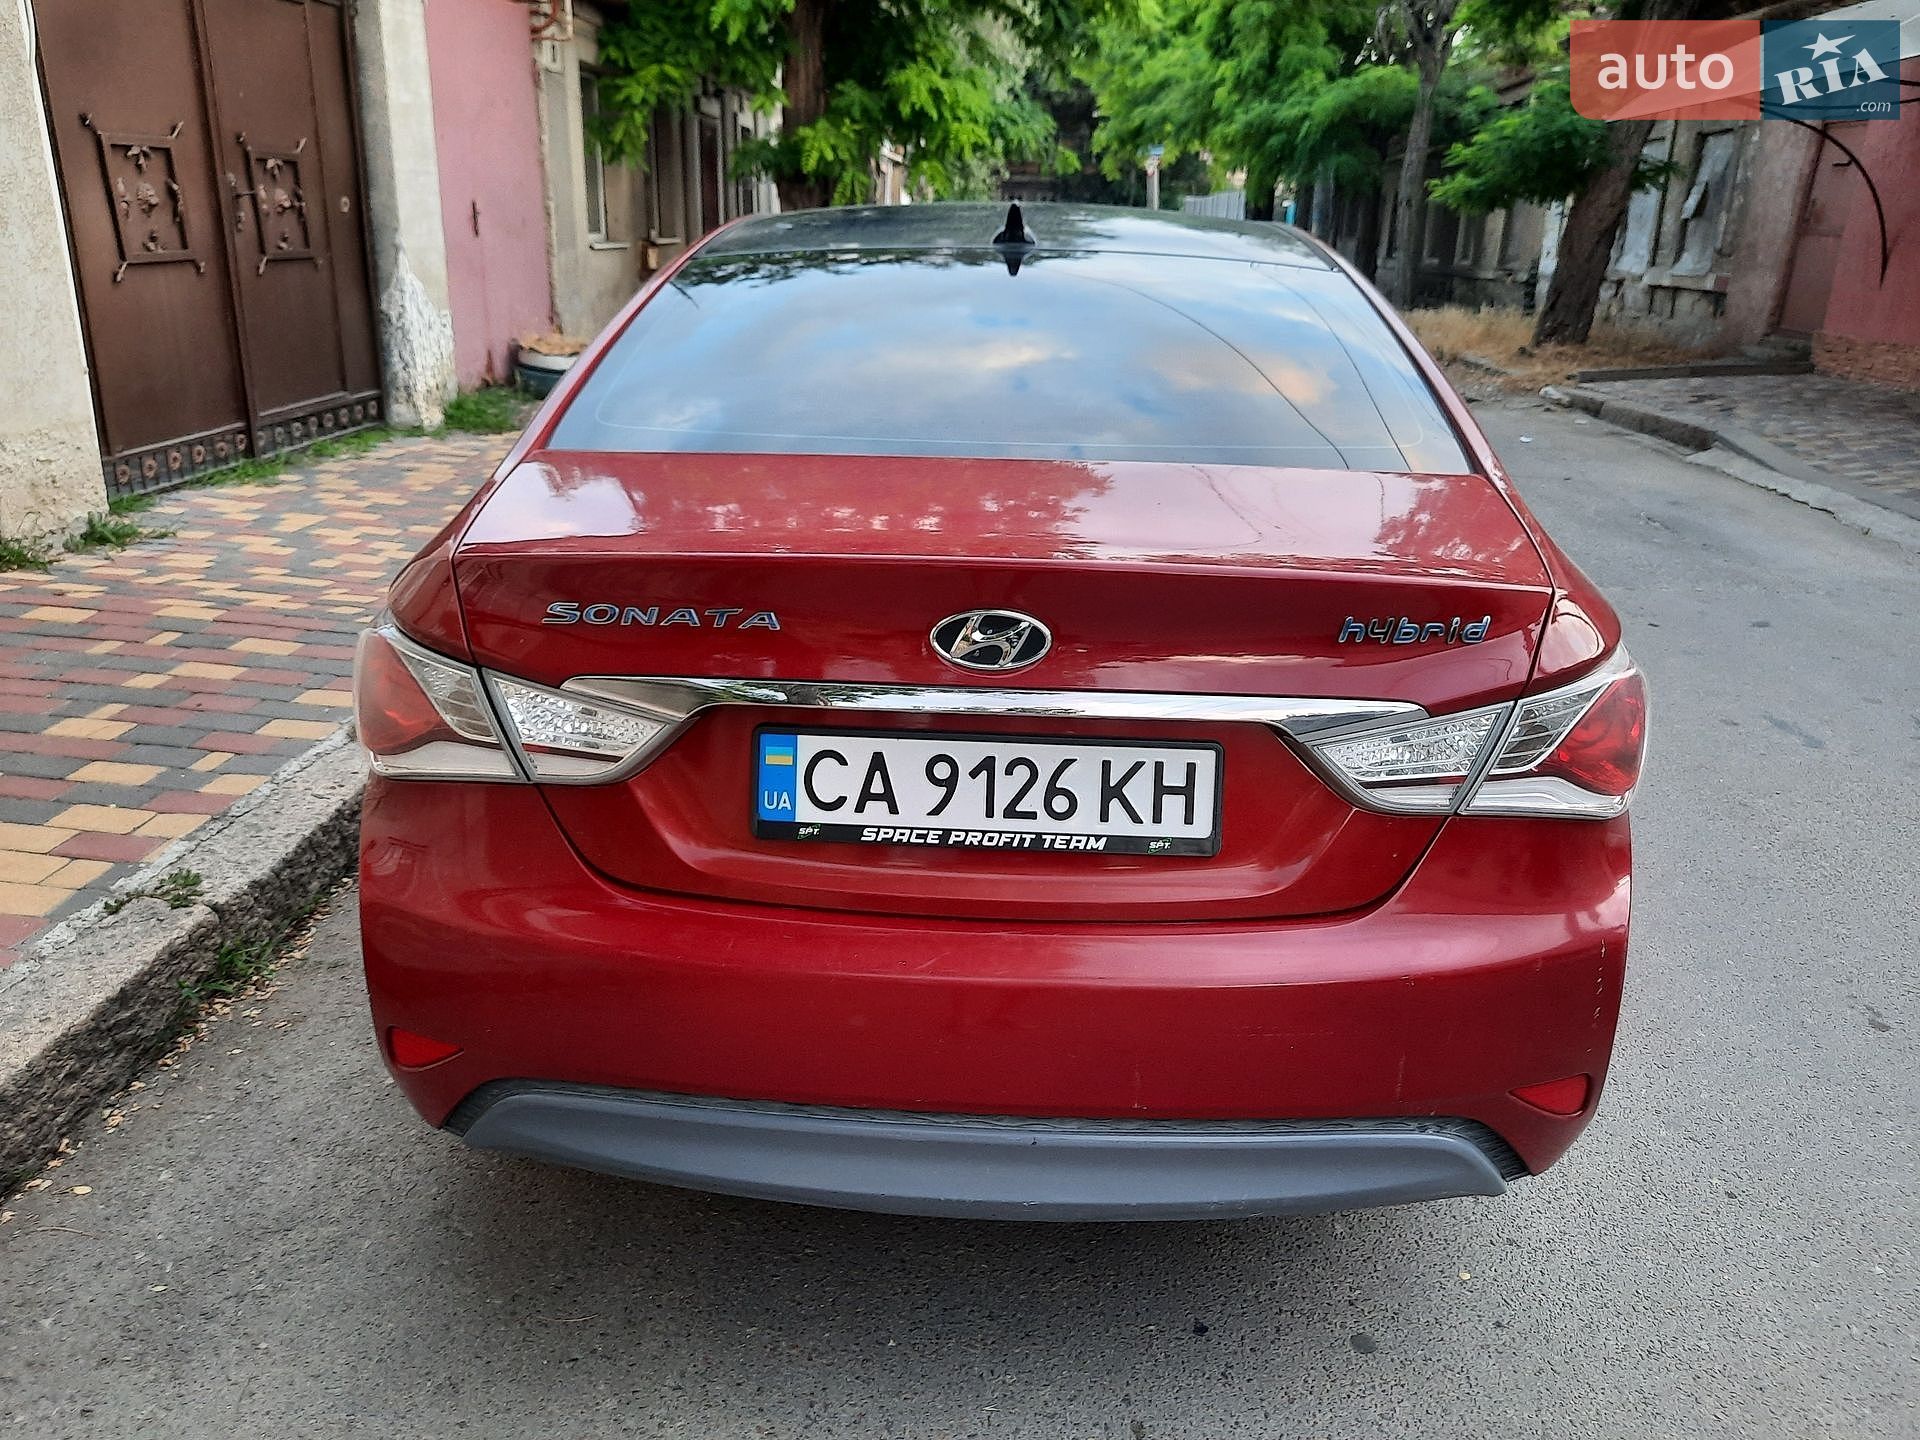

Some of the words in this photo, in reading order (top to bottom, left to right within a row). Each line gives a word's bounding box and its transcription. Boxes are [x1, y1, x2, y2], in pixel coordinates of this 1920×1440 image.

[541, 602, 781, 631] SONATA
[1338, 616, 1492, 644] hybrid
[764, 791, 792, 811] UA
[803, 749, 900, 816] CA
[925, 753, 1079, 821] 9126
[1100, 759, 1197, 825] KH
[860, 827, 943, 844] SPACE
[948, 831, 1037, 848] PROFIT
[1042, 834, 1108, 850] TEAM
